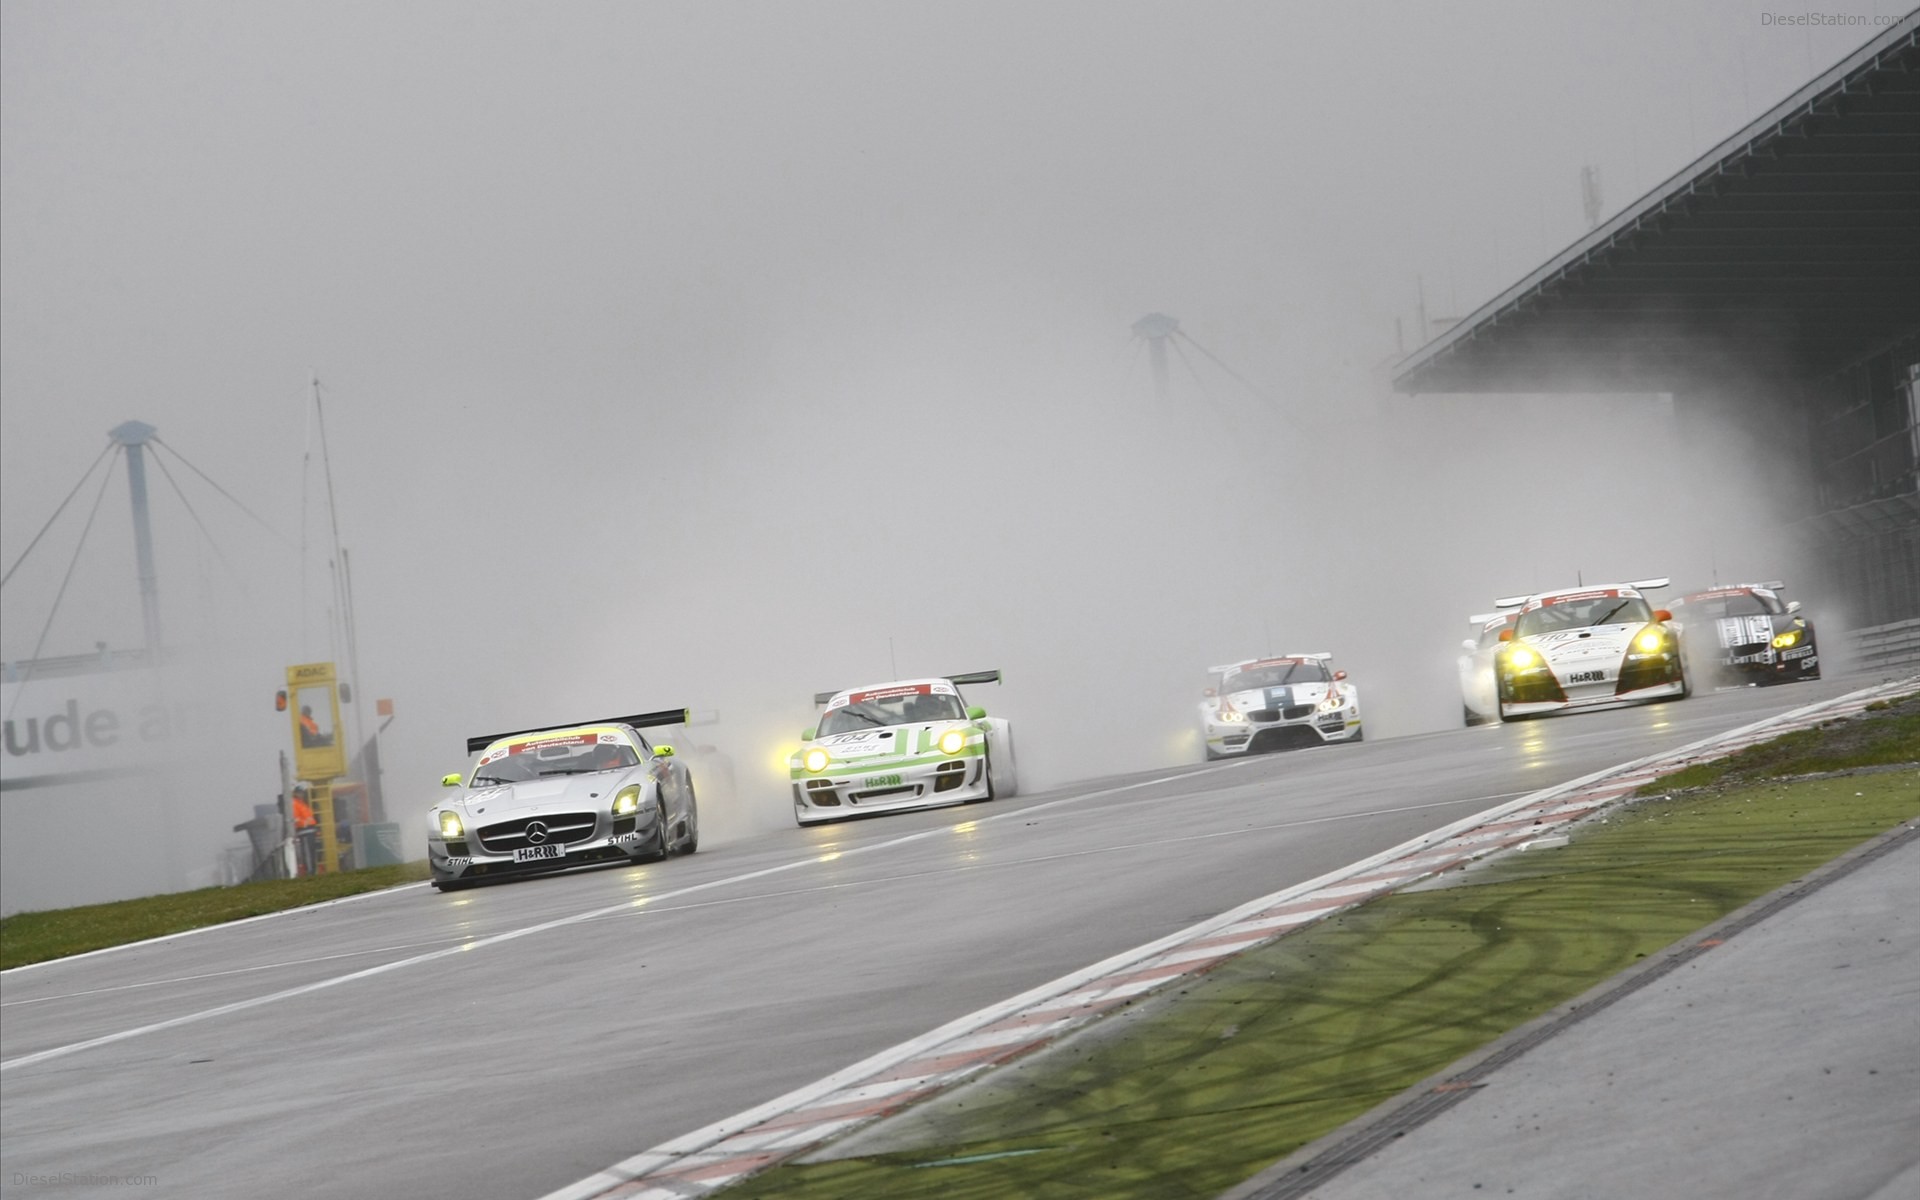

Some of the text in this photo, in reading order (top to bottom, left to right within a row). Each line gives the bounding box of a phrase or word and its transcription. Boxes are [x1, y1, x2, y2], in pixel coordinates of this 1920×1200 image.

[296, 667, 327, 678] ADAC
[607, 833, 638, 846] STIHL
[447, 856, 474, 867] STIHL
